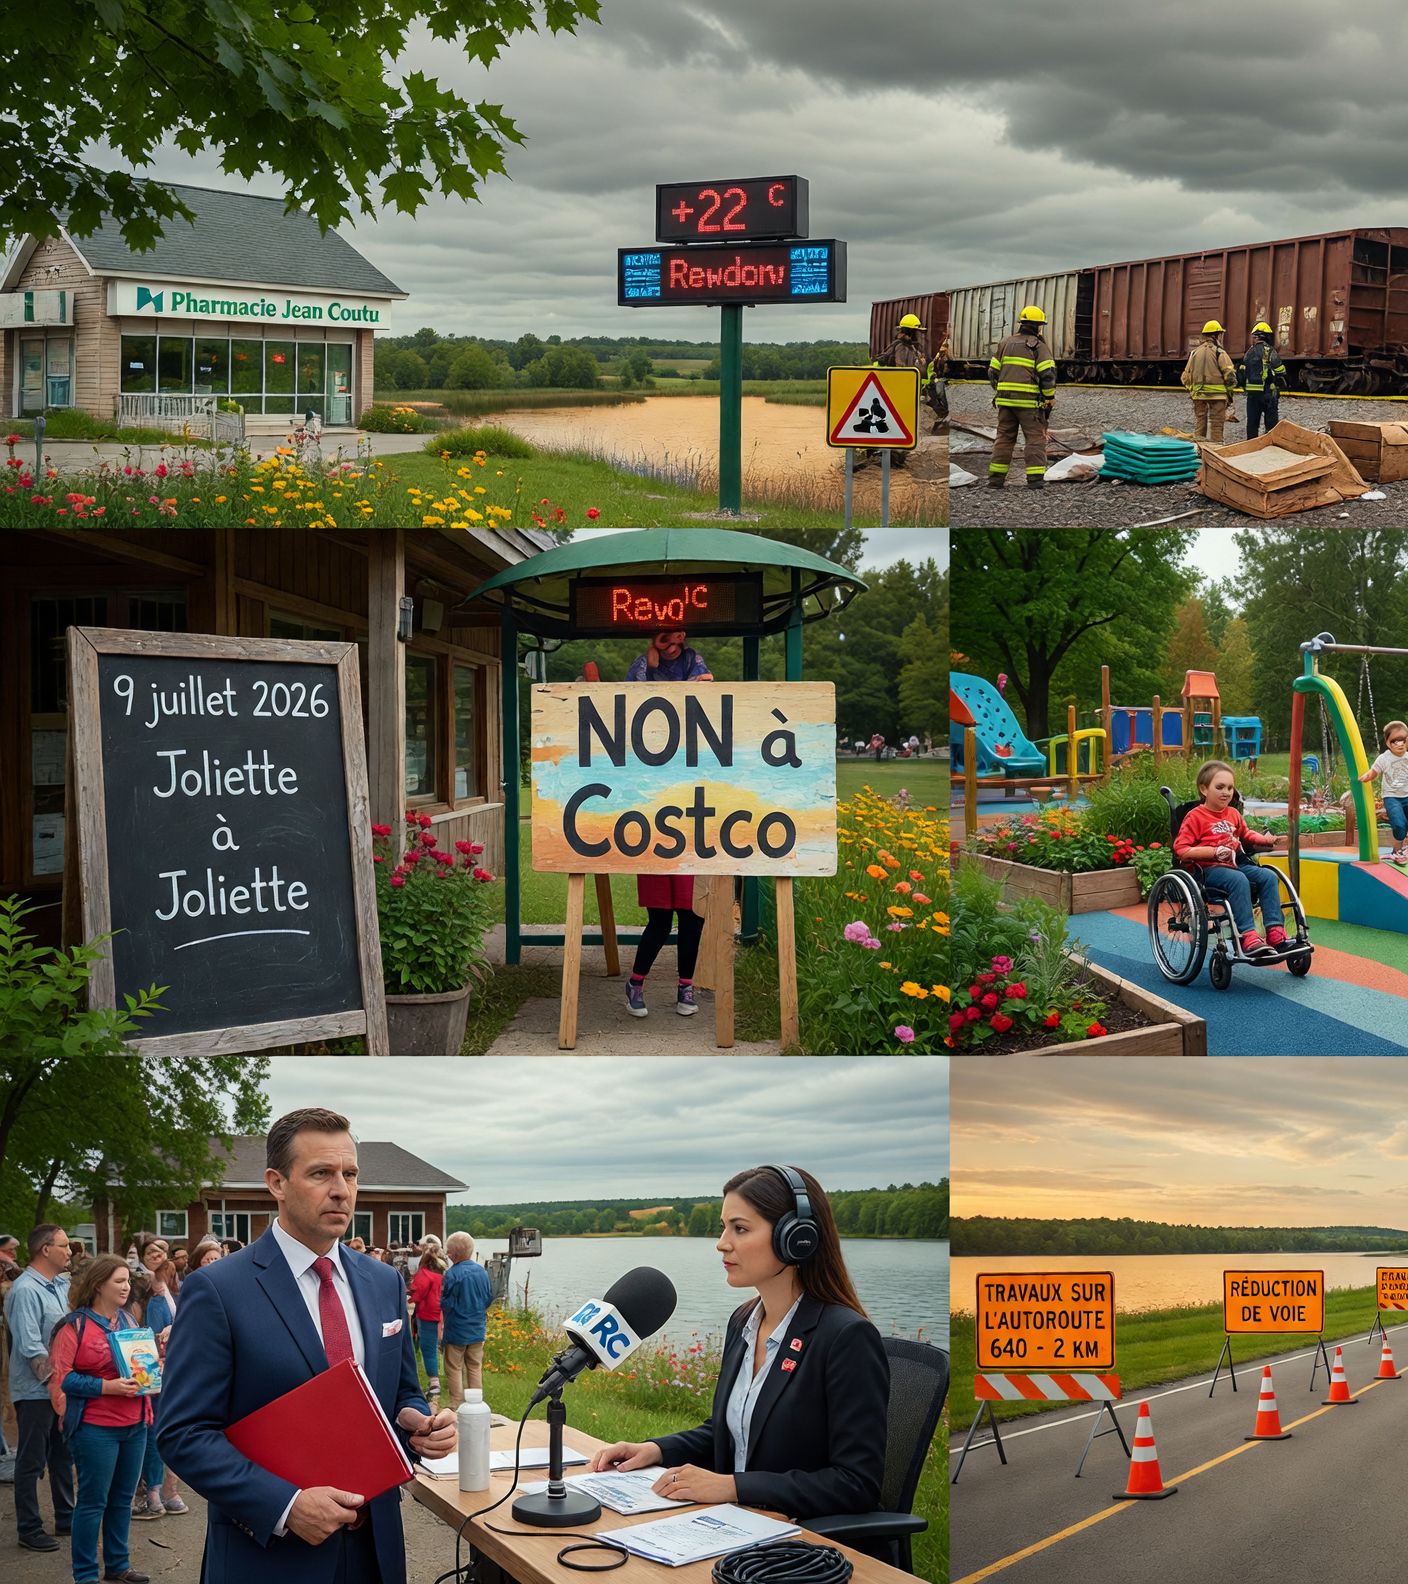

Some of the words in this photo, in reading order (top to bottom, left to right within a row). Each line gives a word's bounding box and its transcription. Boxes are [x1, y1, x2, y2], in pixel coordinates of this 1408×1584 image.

[672, 188, 747, 233] +22
[768, 183, 785, 207] C
[171, 291, 277, 318] Pharmacie
[281, 299, 323, 320] Jean
[327, 302, 380, 323] Coutu
[113, 674, 135, 717] 9
[145, 674, 238, 729] juillet
[252, 680, 330, 718] 2026
[578, 694, 734, 769] NON
[761, 708, 803, 769] à
[153, 749, 300, 799] Joliette
[211, 814, 240, 852] à
[562, 782, 797, 860] Costco
[155, 865, 311, 921] Joliette
[984, 1283, 1063, 1302] TRAVAUX
[1071, 1282, 1106, 1302] SUR
[1231, 1276, 1317, 1297] RÉDUCTION
[985, 1310, 1106, 1330] L'AUTOROUTE
[1242, 1305, 1262, 1322] DE
[1269, 1305, 1306, 1322] VOIE
[589, 1313, 631, 1360] RC
[990, 1338, 1027, 1359] 640
[1053, 1338, 1065, 1358] 2
[1073, 1340, 1099, 1359] KM
